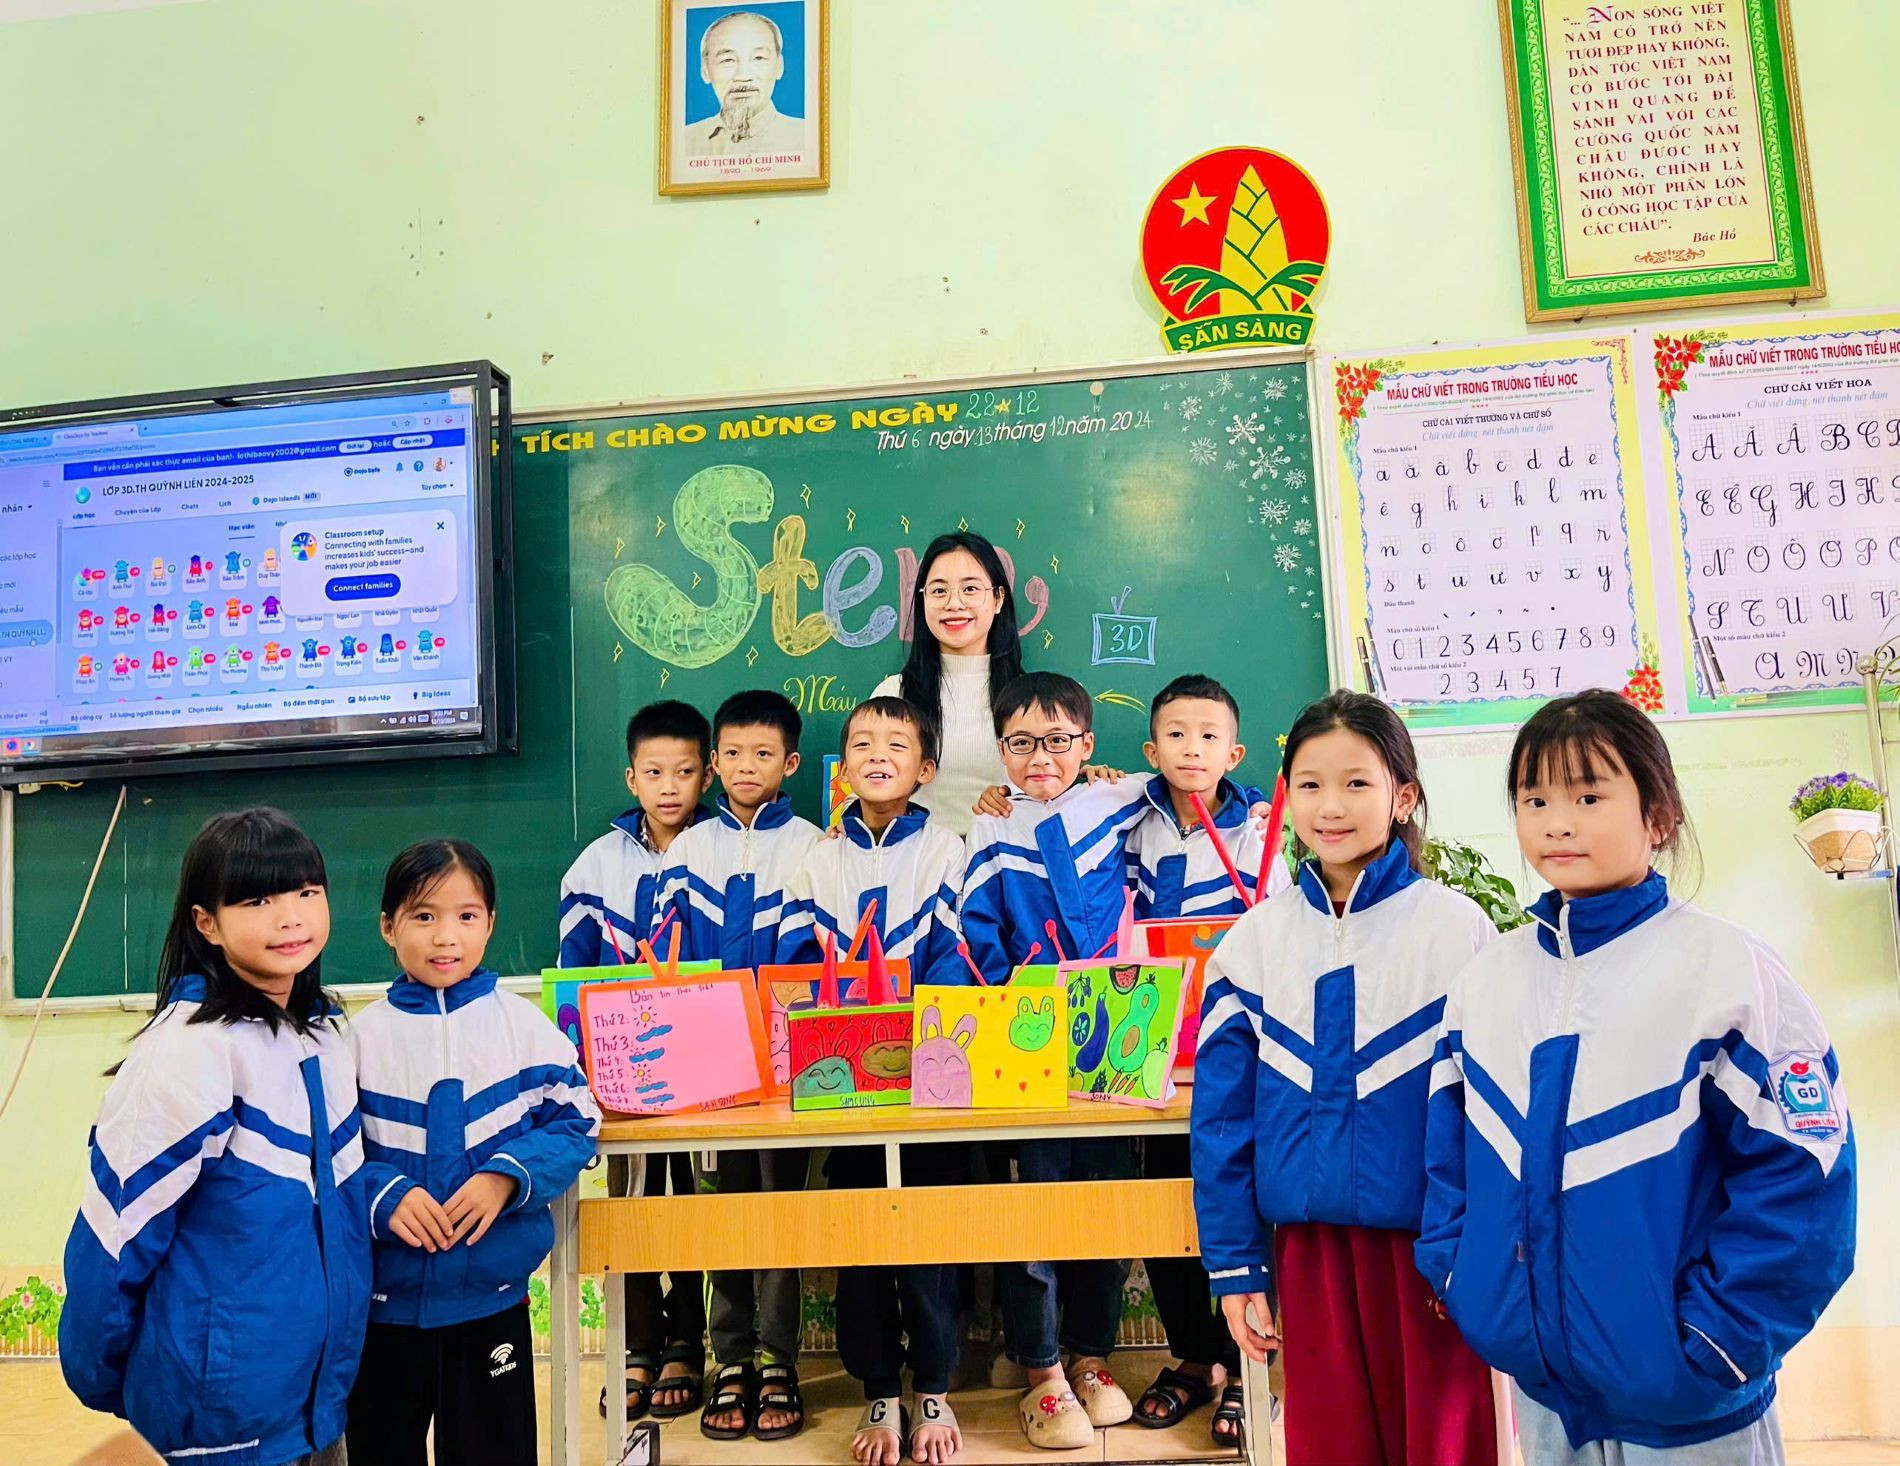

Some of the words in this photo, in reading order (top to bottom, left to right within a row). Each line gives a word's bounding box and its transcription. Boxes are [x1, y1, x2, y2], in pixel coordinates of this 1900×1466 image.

[1643, 6, 1682, 20] SÔNG
[1691, 2, 1726, 15] VIỆT
[1565, 31, 1601, 43] NAM
[1613, 24, 1636, 39] CÓ
[1694, 20, 1727, 32] NÊN
[1638, 41, 1668, 53] HAY
[1568, 64, 1599, 78] DÂN
[1610, 61, 1641, 75] TỘC
[1652, 57, 1686, 71] VIỆT
[1698, 54, 1732, 67] NAM
[1570, 80, 1593, 96] CÓ
[1605, 76, 1651, 92] BƯỚC
[1663, 72, 1692, 87] TỚI
[1704, 71, 1734, 84] ĐÀI
[1572, 98, 1618, 112] VINH
[1633, 92, 1699, 109] QUANG
[1713, 85, 1736, 101] ĐỂ
[1573, 114, 1615, 130] SÁNH
[1628, 112, 1654, 125] VAI
[1666, 107, 1694, 121] VỚI
[1706, 105, 1738, 119] CÁC
[1575, 132, 1633, 148] CƯỜNG
[1645, 125, 1691, 143] QUỐC
[1641, 144, 1691, 160] ĐƯỢC
[1705, 141, 1742, 155] HAY
[689, 156, 710, 167] CHỦ
[712, 156, 736, 168] TỊCH
[755, 154, 772, 165] CHÍ
[775, 154, 801, 163] MINH
[1656, 161, 1711, 176] CHÍNH
[1580, 185, 1612, 200] NHỜ
[1622, 180, 1656, 196] MỘT
[1665, 176, 1706, 193] PHẦN
[1716, 174, 1746, 189] LỚN
[1598, 200, 1640, 216] CÔNG
[1646, 199, 1679, 215] HỌC
[1685, 197, 1712, 212] TẬP
[1717, 194, 1748, 207] CỦA
[1583, 220, 1614, 236] CÁC
[1693, 231, 1715, 243] Bác
[1719, 228, 1737, 241] Hồ
[1234, 318, 1302, 340] SÀNG
[1709, 348, 1733, 368] MẪU
[1736, 349, 1758, 366] CHỮ
[1759, 345, 1781, 364] VIẾT
[1785, 347, 1818, 362] TRONG
[1822, 341, 1862, 359] TRƯỜNG
[1864, 336, 1887, 356] TIỂU
[1387, 381, 1409, 400] MẪU
[1411, 383, 1432, 399] CHỮ
[1434, 379, 1454, 396] VIẾT
[1456, 381, 1489, 395] TRONG
[1492, 376, 1532, 391] TRƯỜNG
[1533, 368, 1555, 388] TIỂU
[1557, 373, 1579, 390] HỌC
[1764, 383, 1790, 394] CHỮ
[1816, 378, 1844, 390] VIẾT
[1847, 379, 1872, 388] HOA
[522, 430, 594, 454] TÍCH
[607, 422, 707, 449] CHÀO
[719, 414, 837, 440] MỪNG
[851, 402, 958, 429] NGÀY
[1422, 415, 1439, 428] CHỮ
[1455, 412, 1474, 425] VIẾT
[1523, 409, 1540, 421] CHỮ
[928, 425, 976, 450] ngày
[994, 419, 1047, 443] tháng
[1065, 416, 1106, 435] năm
[1692, 433, 1722, 461] A
[1820, 424, 1850, 450] B
[1857, 421, 1881, 448] C
[205, 475, 255, 488] 2024-2025
[324, 529, 363, 539] Classroom
[364, 527, 384, 538] setup
[324, 538, 366, 550] Connecting
[367, 536, 384, 547] with
[385, 535, 413, 546] families
[324, 549, 359, 561] increases
[324, 560, 348, 571] makes
[349, 560, 365, 570] your
[366, 558, 378, 569] job
[380, 556, 402, 567] easier
[333, 582, 364, 593] Connect
[365, 580, 394, 591] families
[1109, 623, 1142, 653] 3D
[1393, 639, 1404, 660] 0
[1416, 637, 1423, 658] 1
[1439, 636, 1450, 657] 2
[1462, 634, 1474, 656] 3
[1486, 634, 1500, 654] 4
[1508, 632, 1521, 653] 5
[1532, 630, 1544, 651] 6
[1555, 628, 1567, 650] 7
[1579, 627, 1592, 648] 8
[1602, 625, 1615, 647] 9
[1798, 1087, 1818, 1099] GD
[1795, 1117, 1821, 1128] QUỲNH
